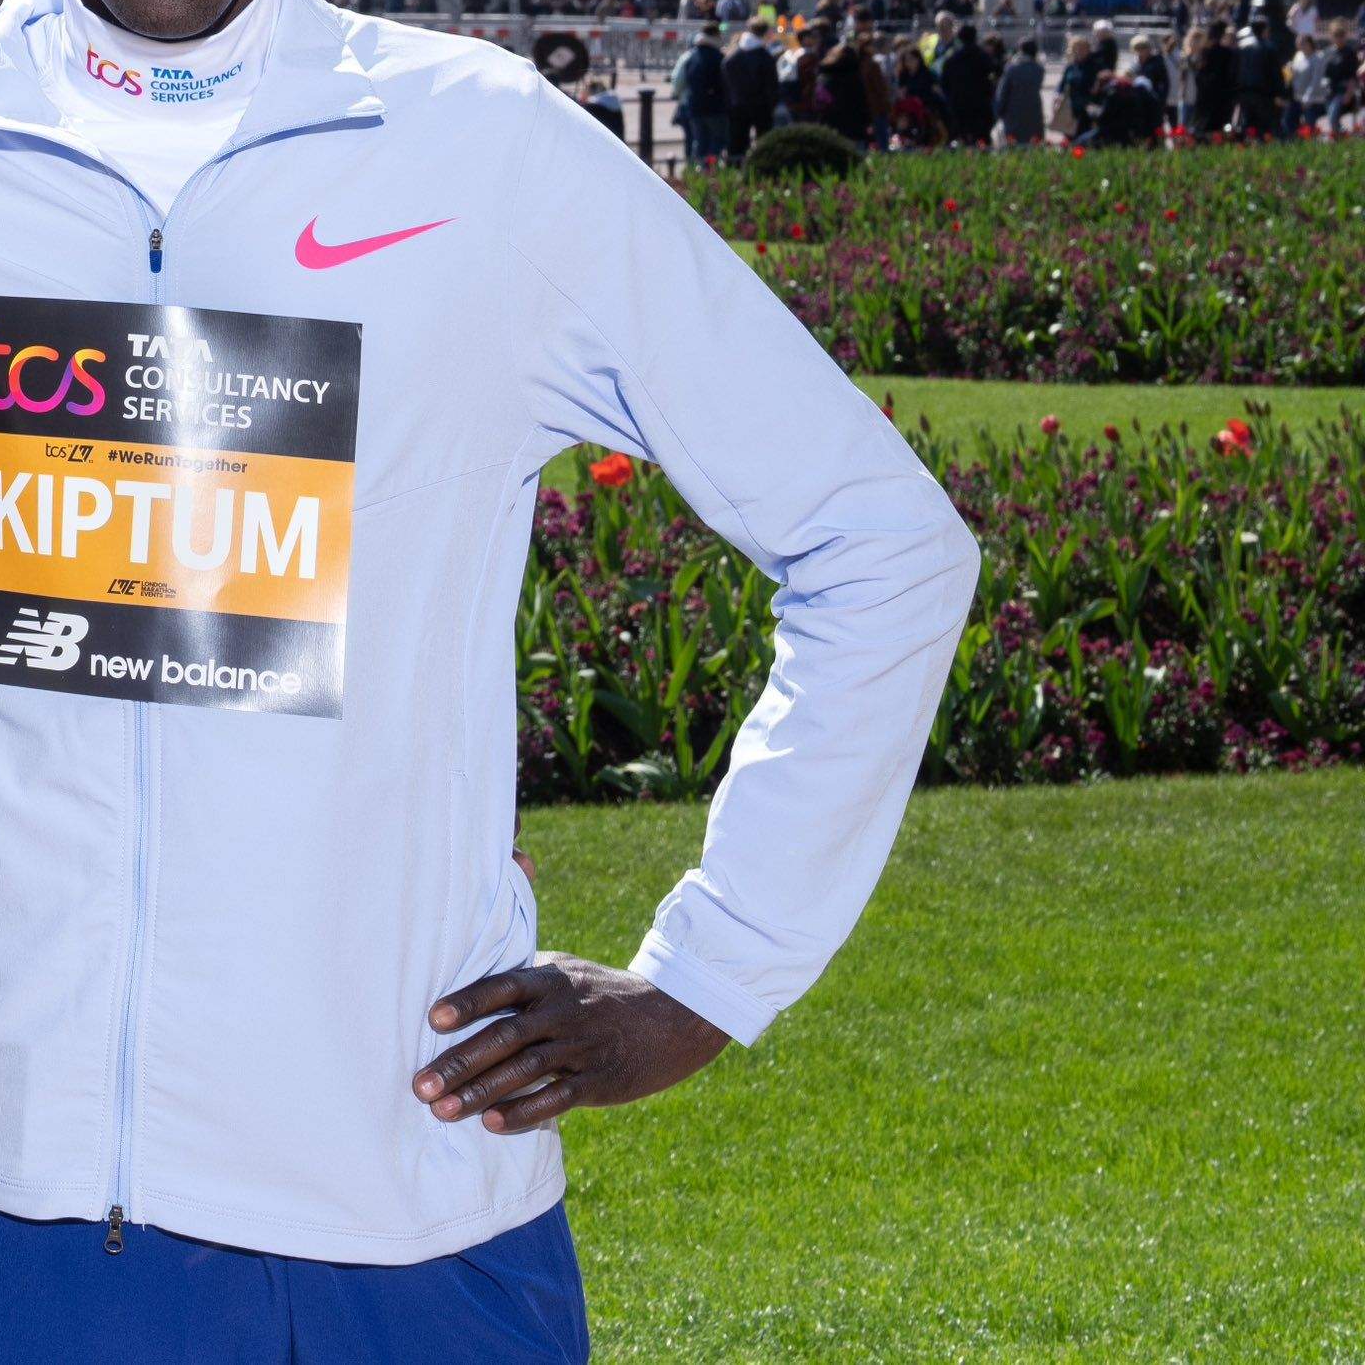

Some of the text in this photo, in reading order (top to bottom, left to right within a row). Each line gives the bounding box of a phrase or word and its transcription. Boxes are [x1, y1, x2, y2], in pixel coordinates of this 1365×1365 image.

[87, 43, 142, 96] tcs
[150, 61, 243, 91] CONSULTANCY
[151, 68, 193, 79] TATA
[151, 89, 214, 103] SERVICES
[127, 334, 213, 362] TAA
[125, 365, 331, 405] COULTANCY
[123, 396, 252, 430] SERCES
[45, 443, 67, 459] tcs
[108, 450, 248, 473] #WeRunTogether
[90, 653, 154, 681] new
[161, 655, 303, 695] balance
